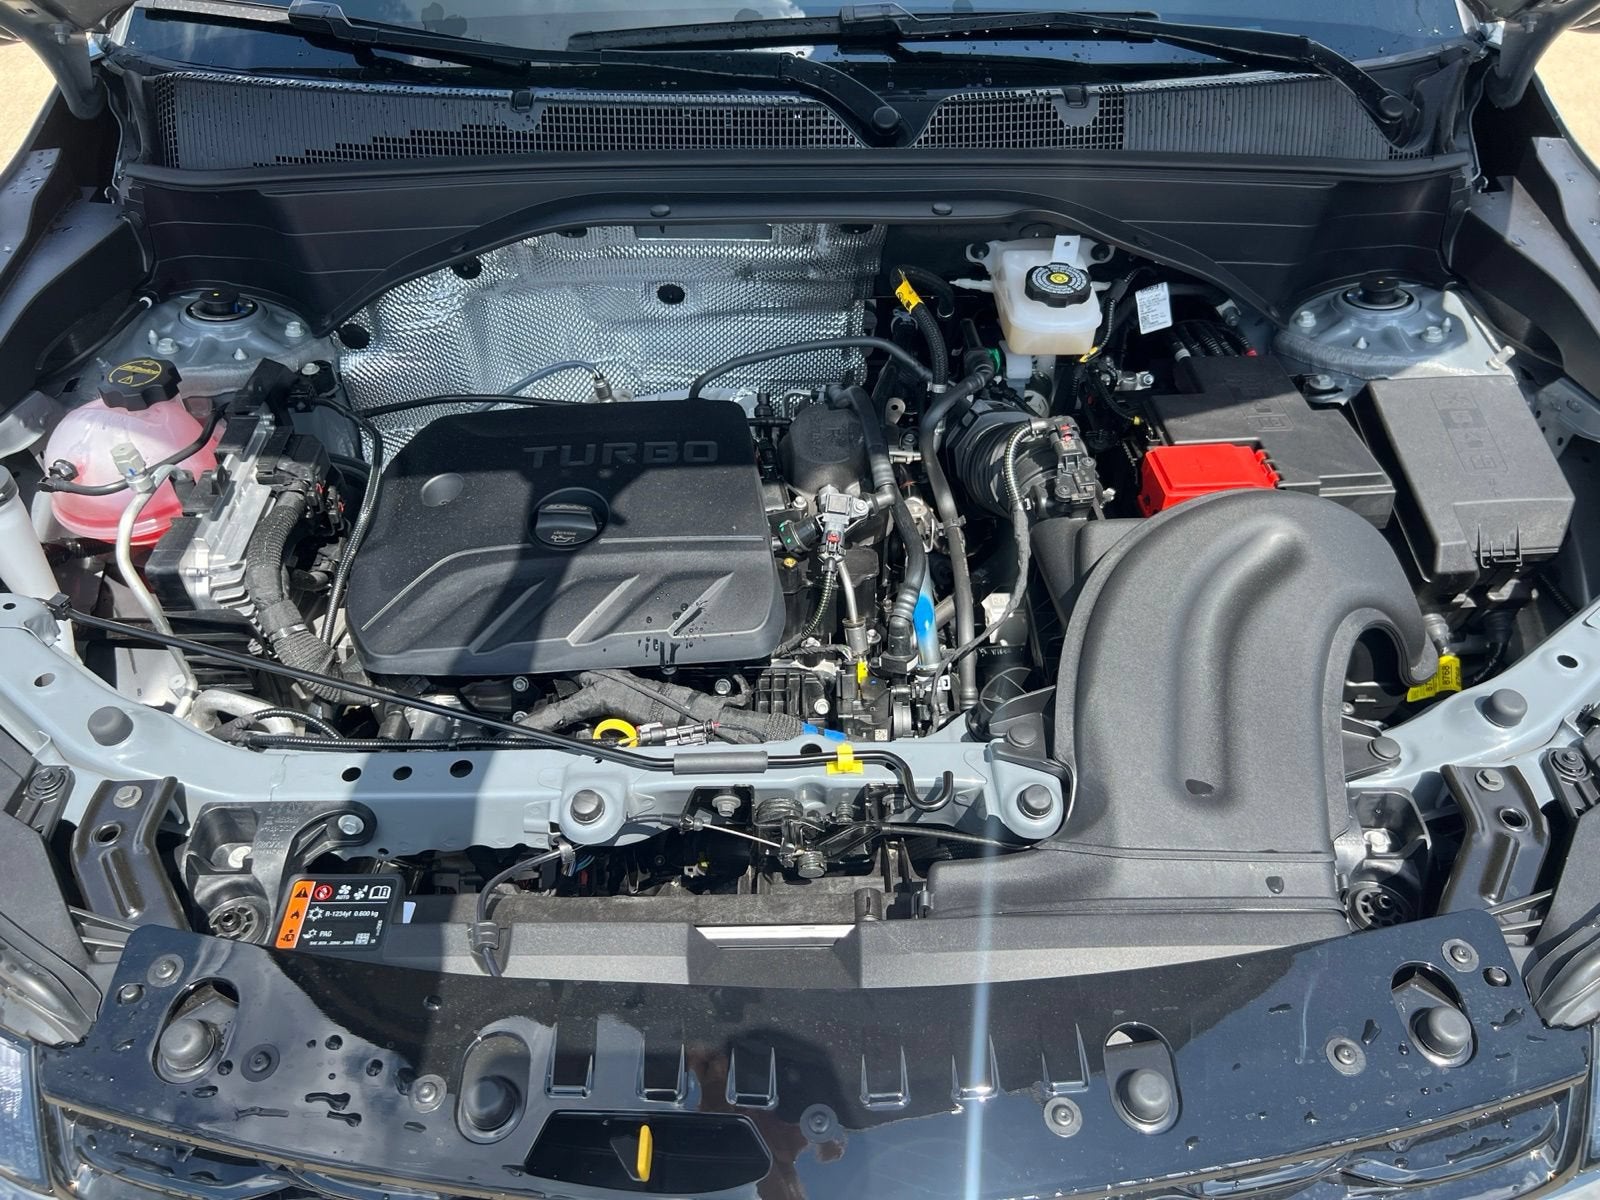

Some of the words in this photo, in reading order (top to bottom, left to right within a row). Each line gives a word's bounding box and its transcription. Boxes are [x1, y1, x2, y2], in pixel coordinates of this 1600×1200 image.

[523, 440, 718, 469] TURBO
[371, 910, 379, 918] kg
[319, 930, 333, 938] PAG
